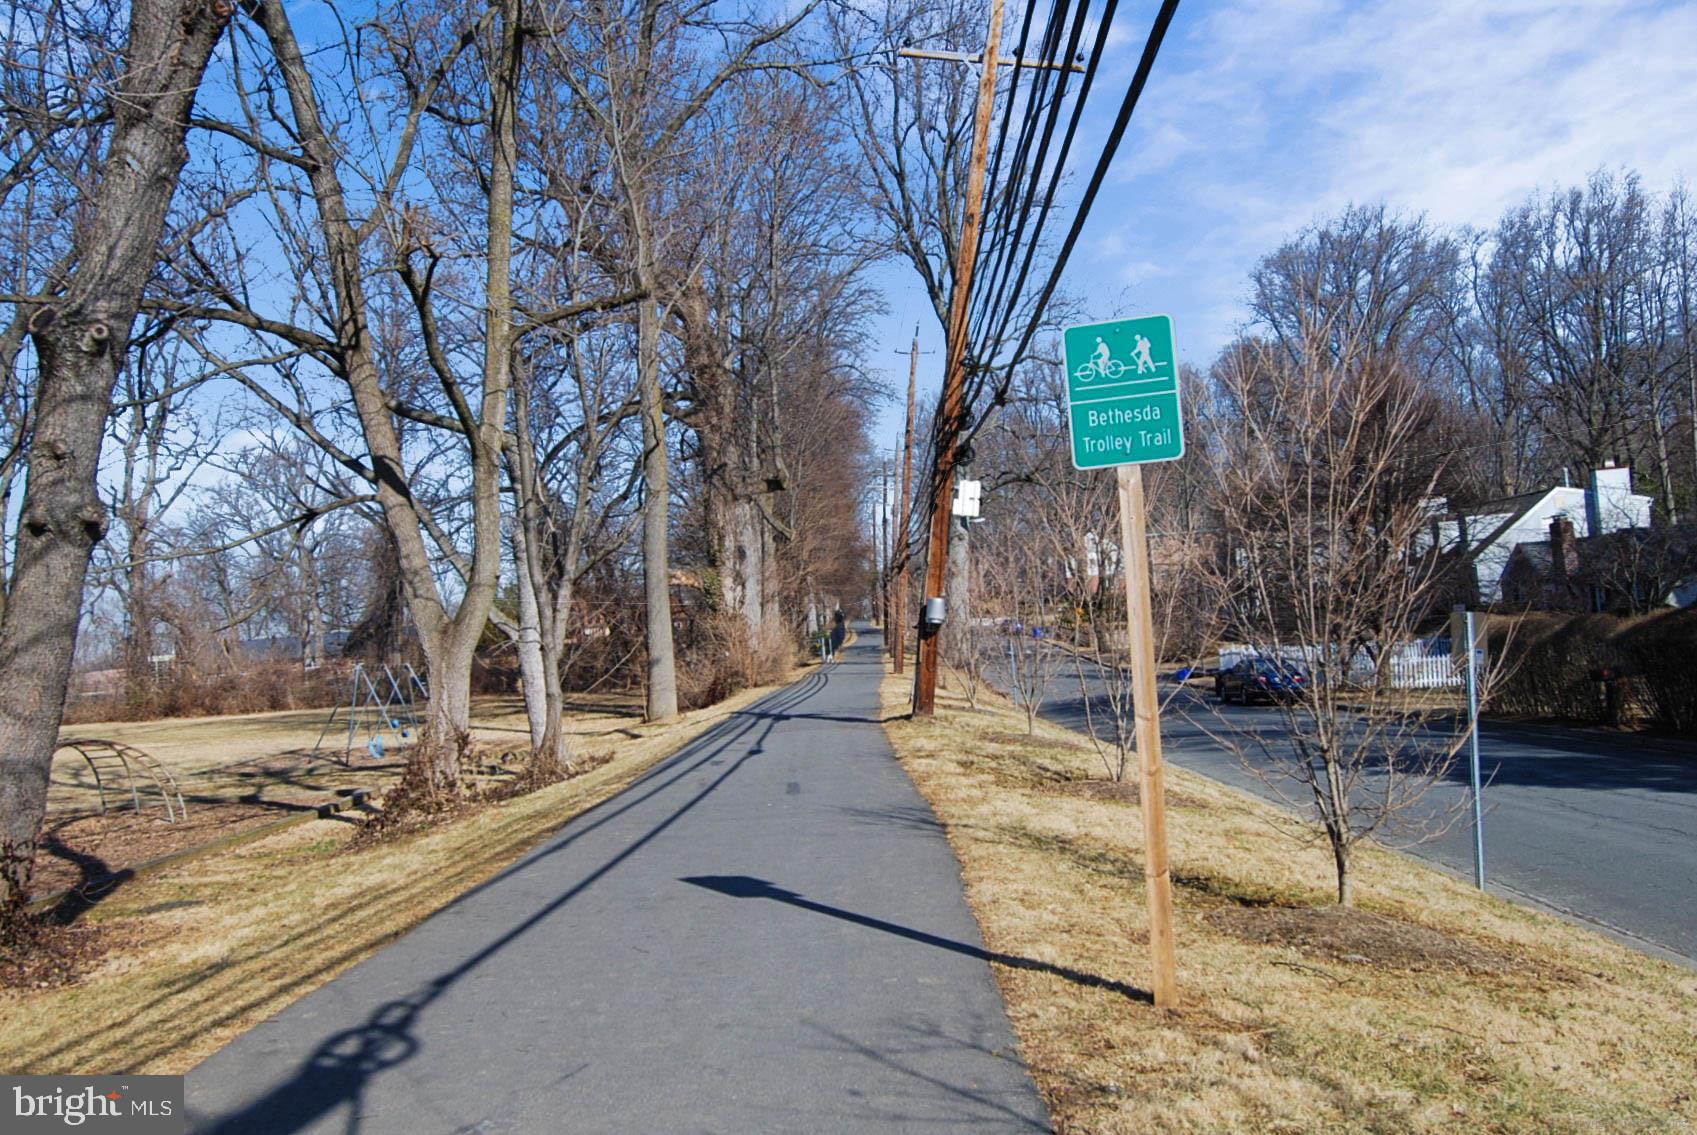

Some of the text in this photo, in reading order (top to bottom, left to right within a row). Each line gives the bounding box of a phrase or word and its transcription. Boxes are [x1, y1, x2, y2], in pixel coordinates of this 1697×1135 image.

[1088, 404, 1161, 427] Bethesda
[1082, 428, 1172, 454] Trolley Trail
